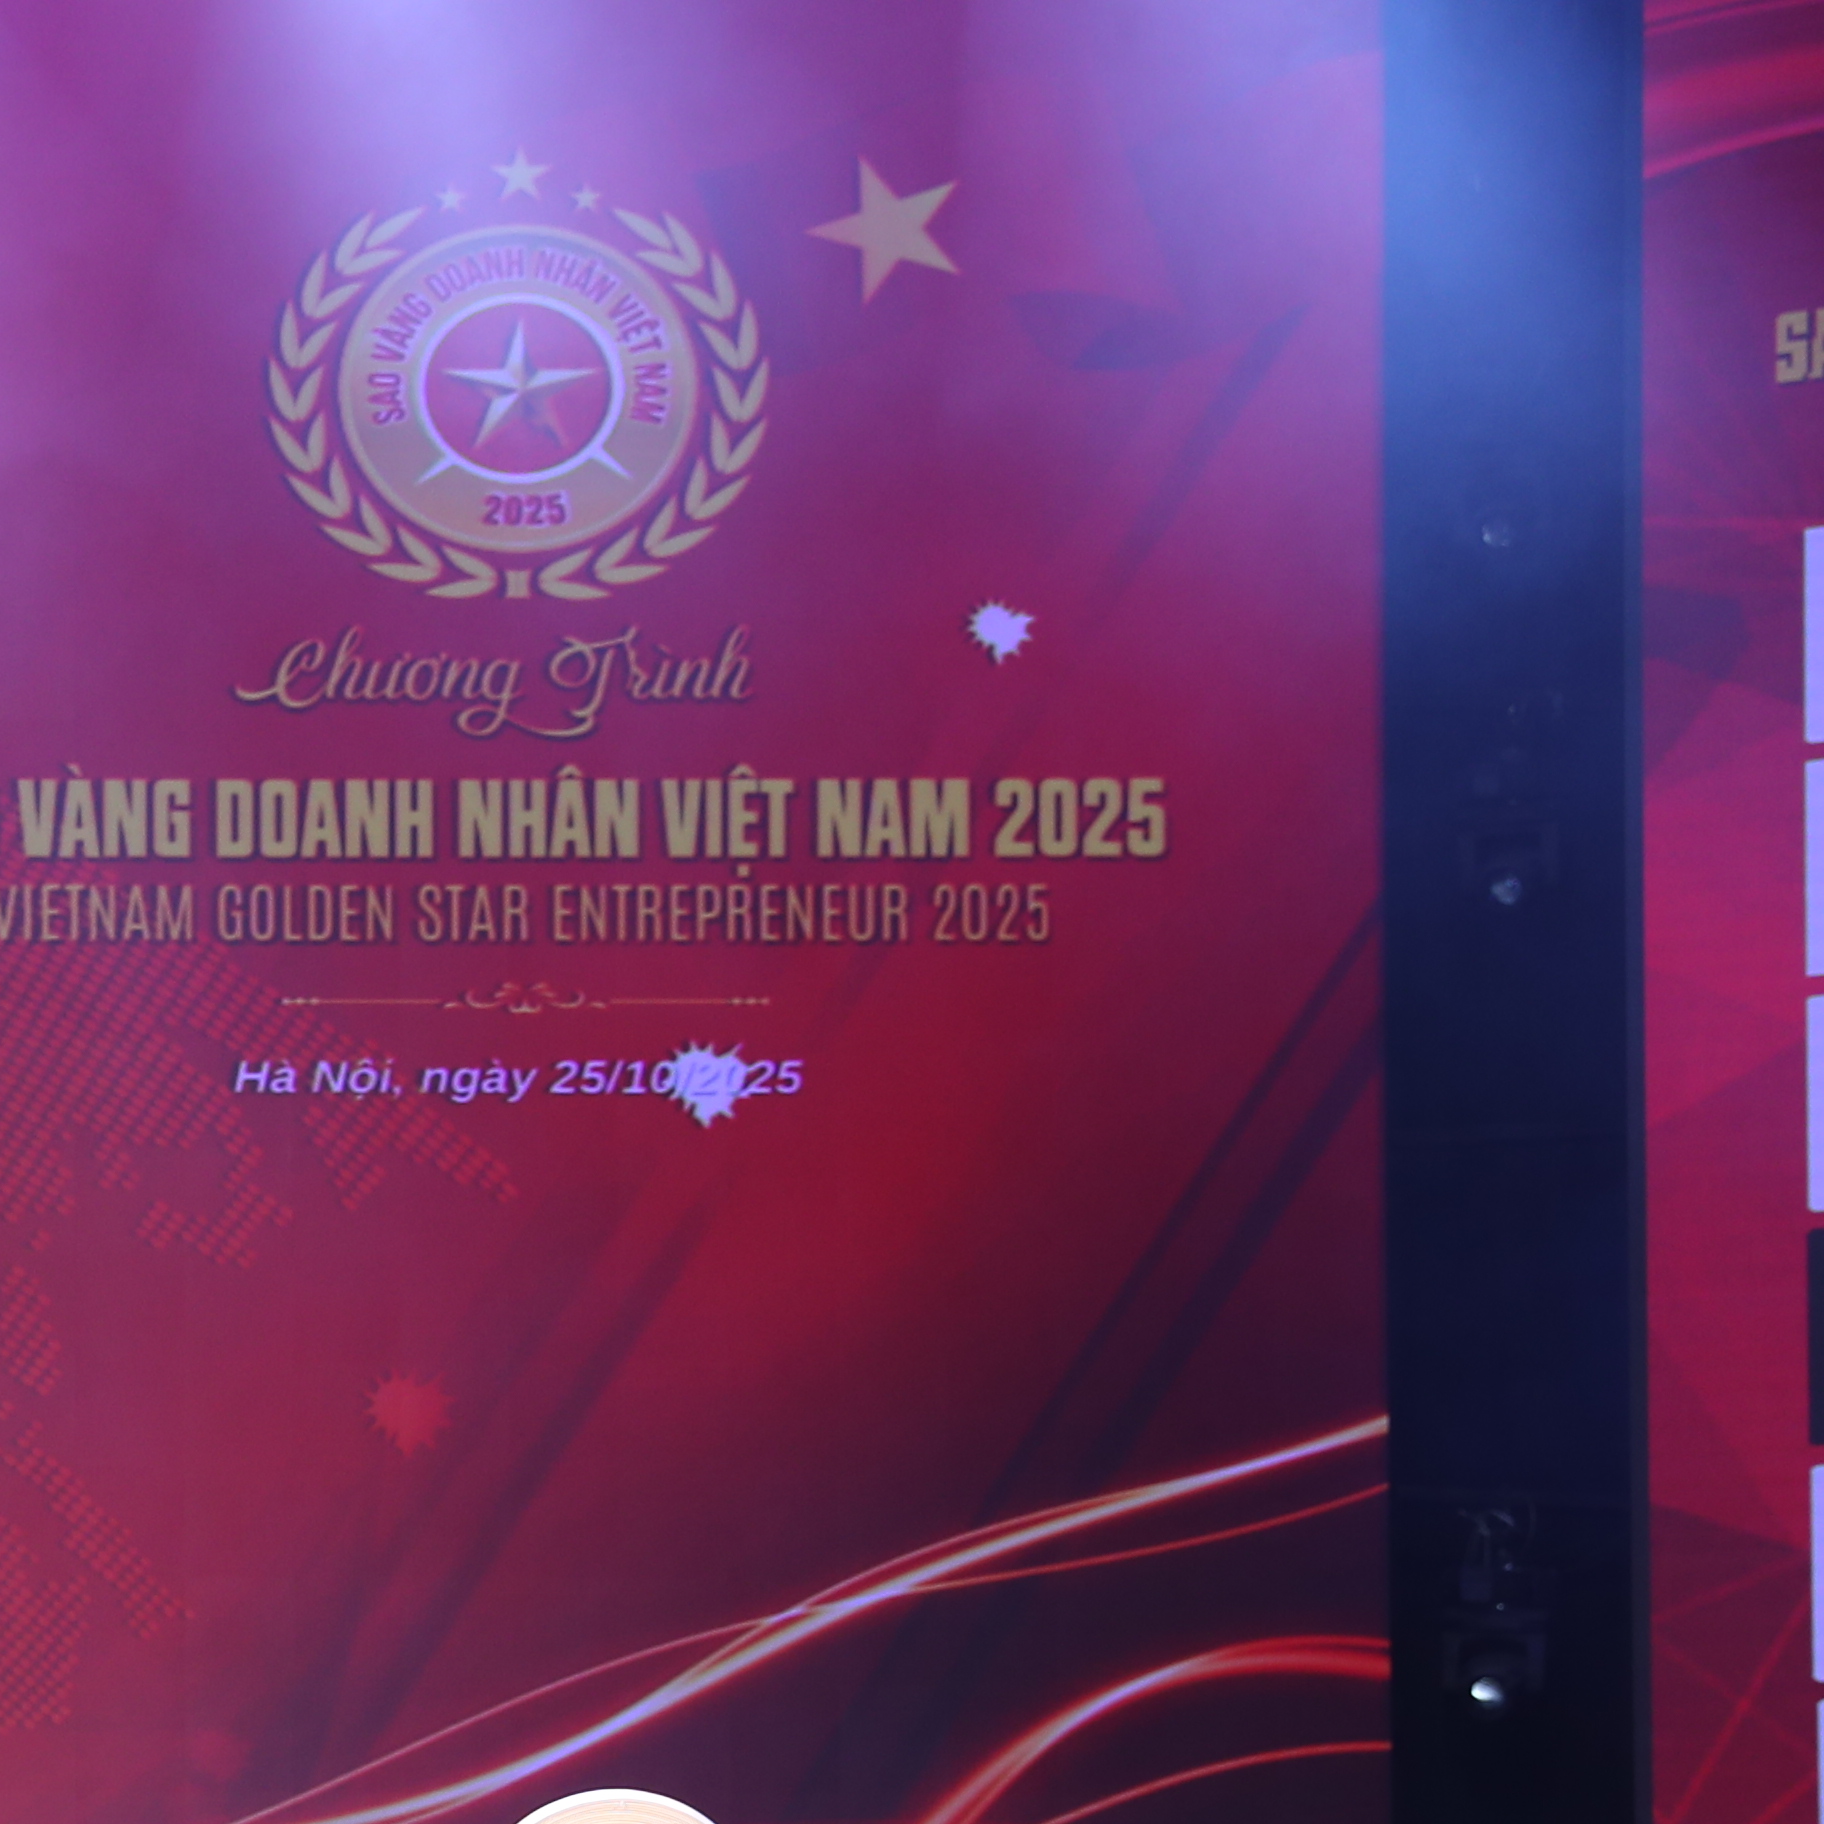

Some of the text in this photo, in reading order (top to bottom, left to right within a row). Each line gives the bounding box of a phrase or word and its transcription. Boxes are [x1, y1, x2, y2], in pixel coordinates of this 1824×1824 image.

[368, 371, 408, 426] SAO
[424, 248, 526, 302] DOANH
[534, 250, 618, 305] NHÂN
[630, 364, 672, 426] NAM
[480, 493, 569, 529] 2025
[17, 763, 192, 859] VÀNG
[216, 778, 434, 858] DOANH
[458, 764, 639, 858] NHÂN
[661, 763, 795, 878] VIỆT
[816, 778, 970, 858] NAM
[993, 777, 1167, 858] 2025
[217, 883, 394, 942] GOLDEN
[417, 883, 528, 942] STAR
[554, 883, 909, 942] ENTREPRENEUR
[933, 883, 1050, 942] 2025
[234, 1060, 298, 1094] Hà
[311, 1059, 403, 1103] Nội,
[420, 1061, 539, 1105] ngày
